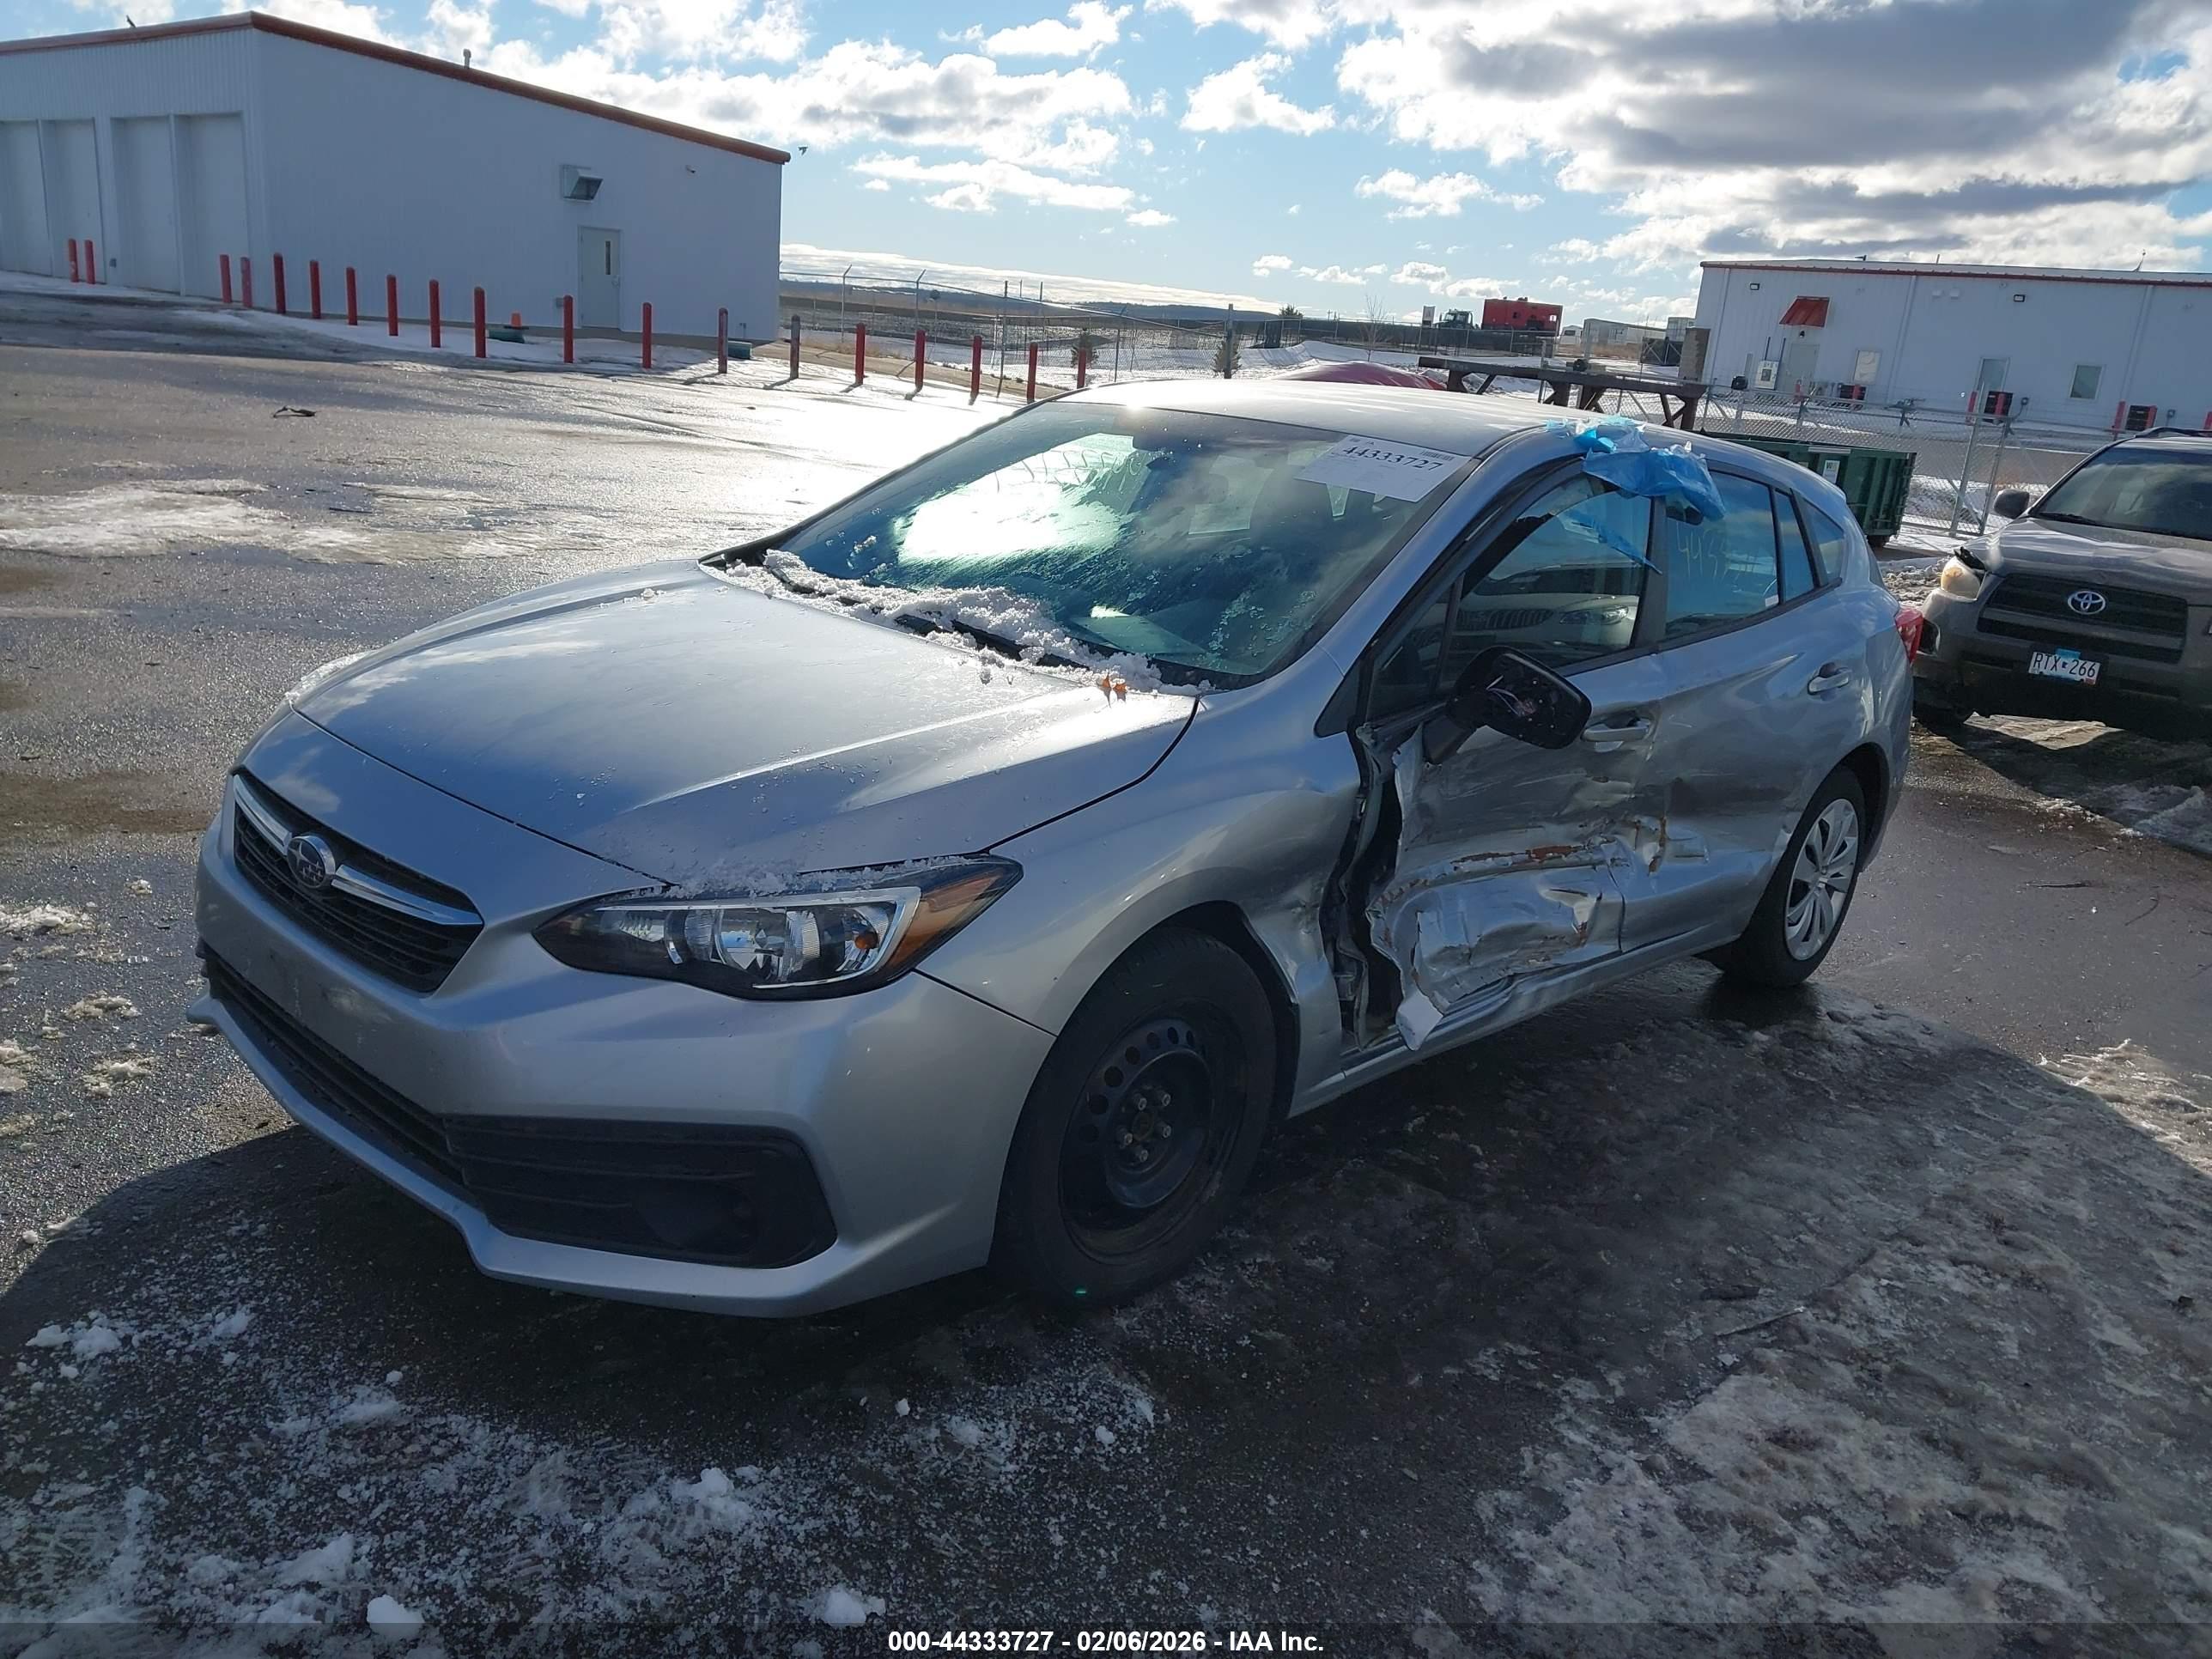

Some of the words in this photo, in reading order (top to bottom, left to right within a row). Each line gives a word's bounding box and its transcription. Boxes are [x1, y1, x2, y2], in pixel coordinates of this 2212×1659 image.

[1342, 446, 1443, 471] 44333727
[2033, 652, 2062, 672] RTX
[2069, 659, 2096, 678] 266
